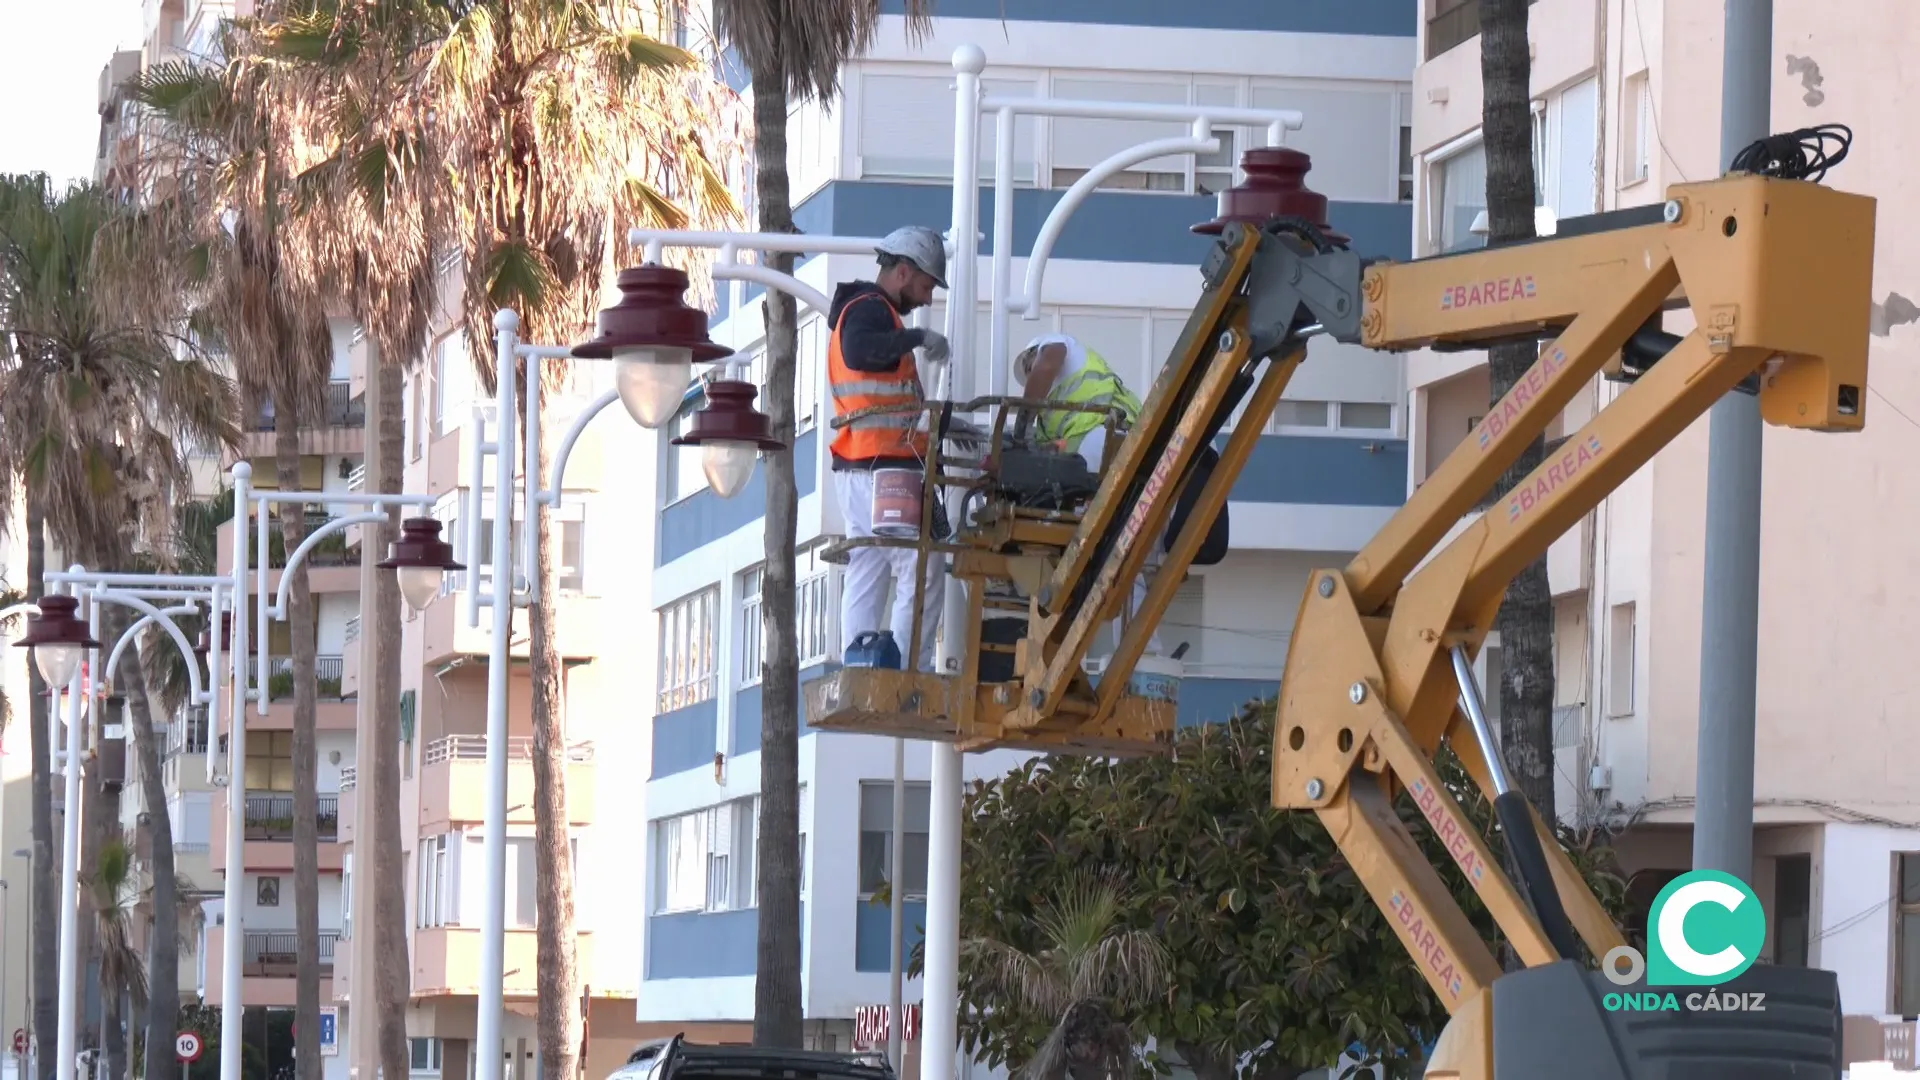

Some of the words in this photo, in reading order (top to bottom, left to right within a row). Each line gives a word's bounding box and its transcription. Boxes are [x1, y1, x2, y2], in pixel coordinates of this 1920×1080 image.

[1452, 276, 1526, 309] BAREA
[1488, 357, 1558, 440] BAREA
[1520, 443, 1594, 513] BAREA
[1417, 786, 1475, 874] BAREA
[1397, 898, 1454, 986] BAREA
[181, 1040, 194, 1051] 10
